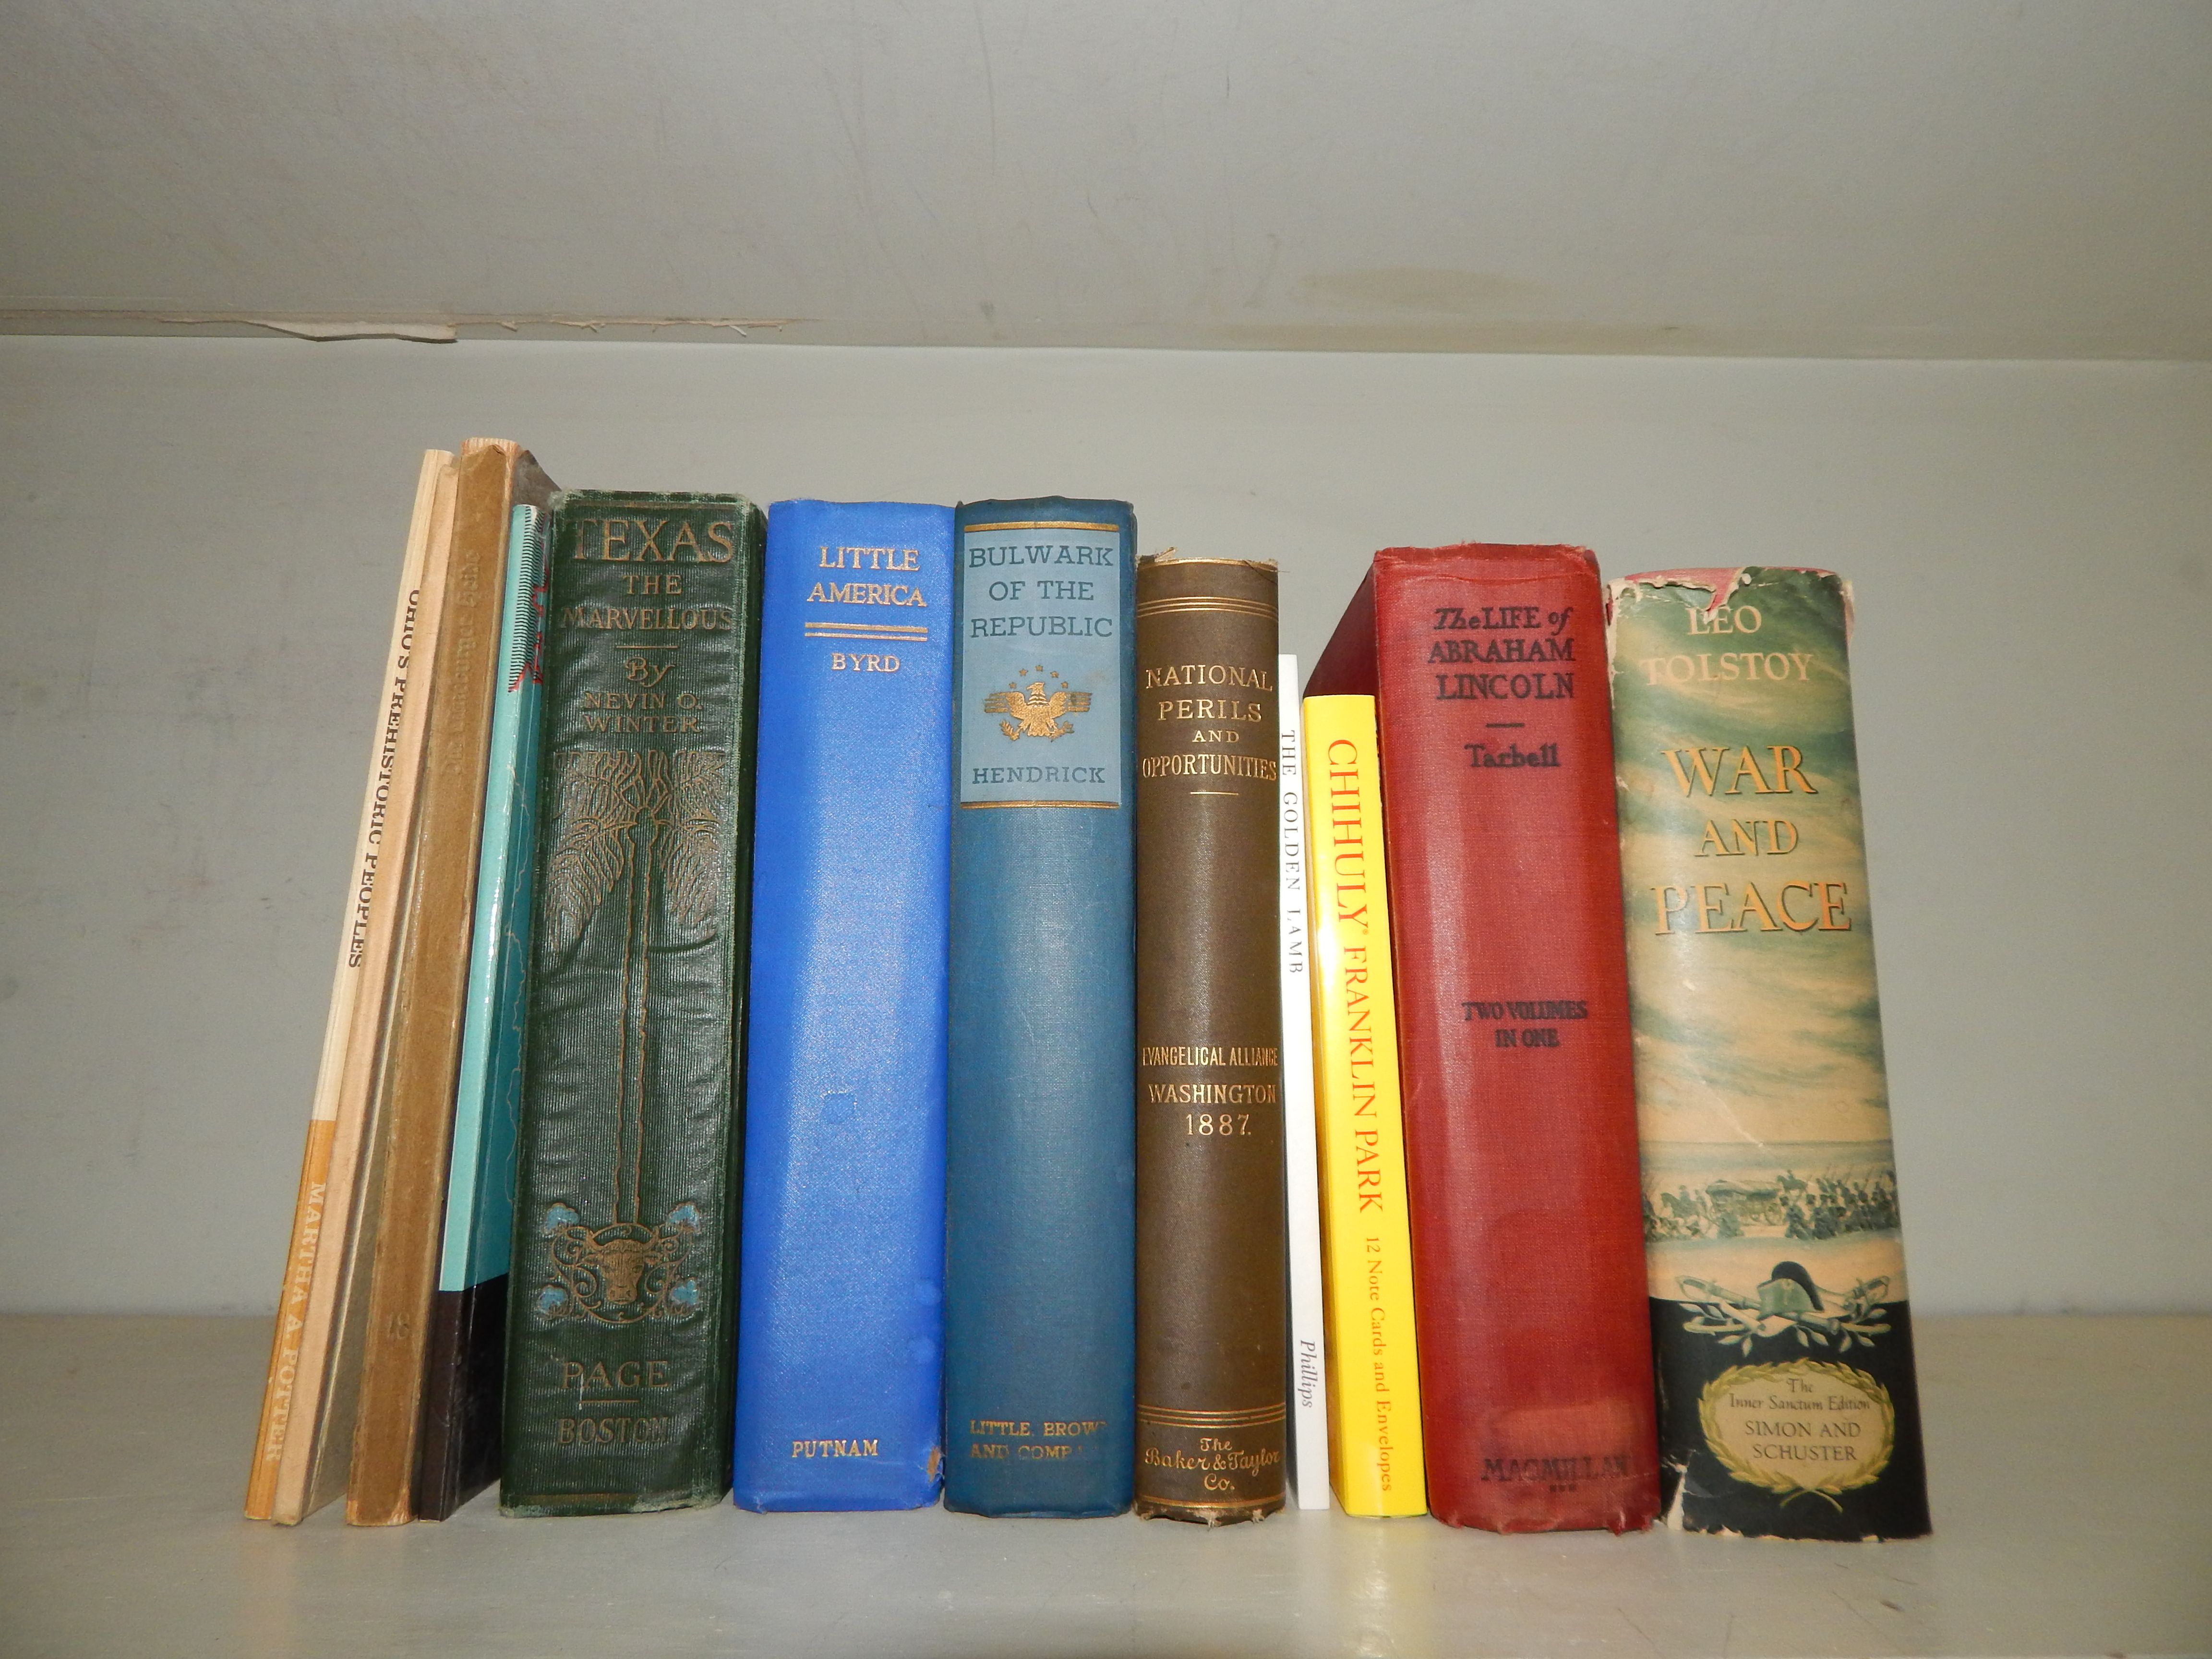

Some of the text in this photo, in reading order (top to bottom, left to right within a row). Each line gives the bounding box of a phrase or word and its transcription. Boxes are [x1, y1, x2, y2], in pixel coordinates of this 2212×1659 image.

[566, 518, 735, 563] TEXAS
[819, 546, 921, 571] LITTLE
[968, 545, 1114, 568] BULWARK
[623, 575, 682, 595] THE
[806, 582, 927, 607] AMERICA
[989, 580, 1094, 601] OF THE
[561, 608, 733, 630] MARVELLOUS
[971, 616, 1113, 638] REPUBLIC
[1433, 606, 1574, 636] The LIFE of
[1685, 605, 1762, 635] LEO
[830, 652, 901, 673] BYRD
[1428, 638, 1576, 663] ABRAHAM
[624, 657, 676, 687] By
[1145, 665, 1273, 692] NATIONAL
[1638, 653, 1815, 685] TOLSTOY
[1435, 673, 1575, 699] LINCOLN
[584, 692, 665, 710] NEVIN
[1158, 699, 1262, 722] PERILS
[584, 715, 703, 733] WINTER
[1192, 730, 1239, 743] AND
[368, 677, 407, 845] PREHISTORIC
[1142, 754, 1277, 781] OPPORTUNITIES
[1464, 743, 1561, 768] Tarbell
[972, 767, 1106, 784] HENDRICK
[1660, 745, 1818, 797] WAR
[1695, 819, 1799, 857] AND
[1281, 730, 1303, 974] THE GOLDEN LAMB
[349, 853, 378, 968] PEOPLES
[1650, 880, 1852, 935] PEACE
[1461, 1000, 1588, 1021] TWO VOLUMES
[1344, 945, 1377, 1118] FRANKLIN
[1495, 1028, 1560, 1048] IN ONE
[1142, 1046, 1278, 1066] EVANGELICAL ALLIANCE
[1148, 1084, 1276, 1104] WASHINGTON
[1355, 1129, 1383, 1213] PARK
[291, 1181, 326, 1304] MARTHA
[563, 1360, 670, 1389] PAGE
[1298, 1340, 1319, 1408] Phillips
[1366, 1237, 1394, 1491] 12 Note Cards and Envelopes
[1787, 1378, 1814, 1393] The
[265, 1347, 299, 1461] POTTER
[1730, 1394, 1870, 1410] Inner Sanctum Edition
[557, 1417, 669, 1444] BOSTON
[1745, 1420, 1861, 1438] SIMON AND
[792, 1439, 878, 1457] PUTNAM
[969, 1443, 1009, 1459] AND
[1200, 1437, 1233, 1452] The
[1753, 1444, 1857, 1461] SCHUSTER
[1145, 1447, 1280, 1477] Baker & Taylor
[1204, 1473, 1235, 1491] Co.
